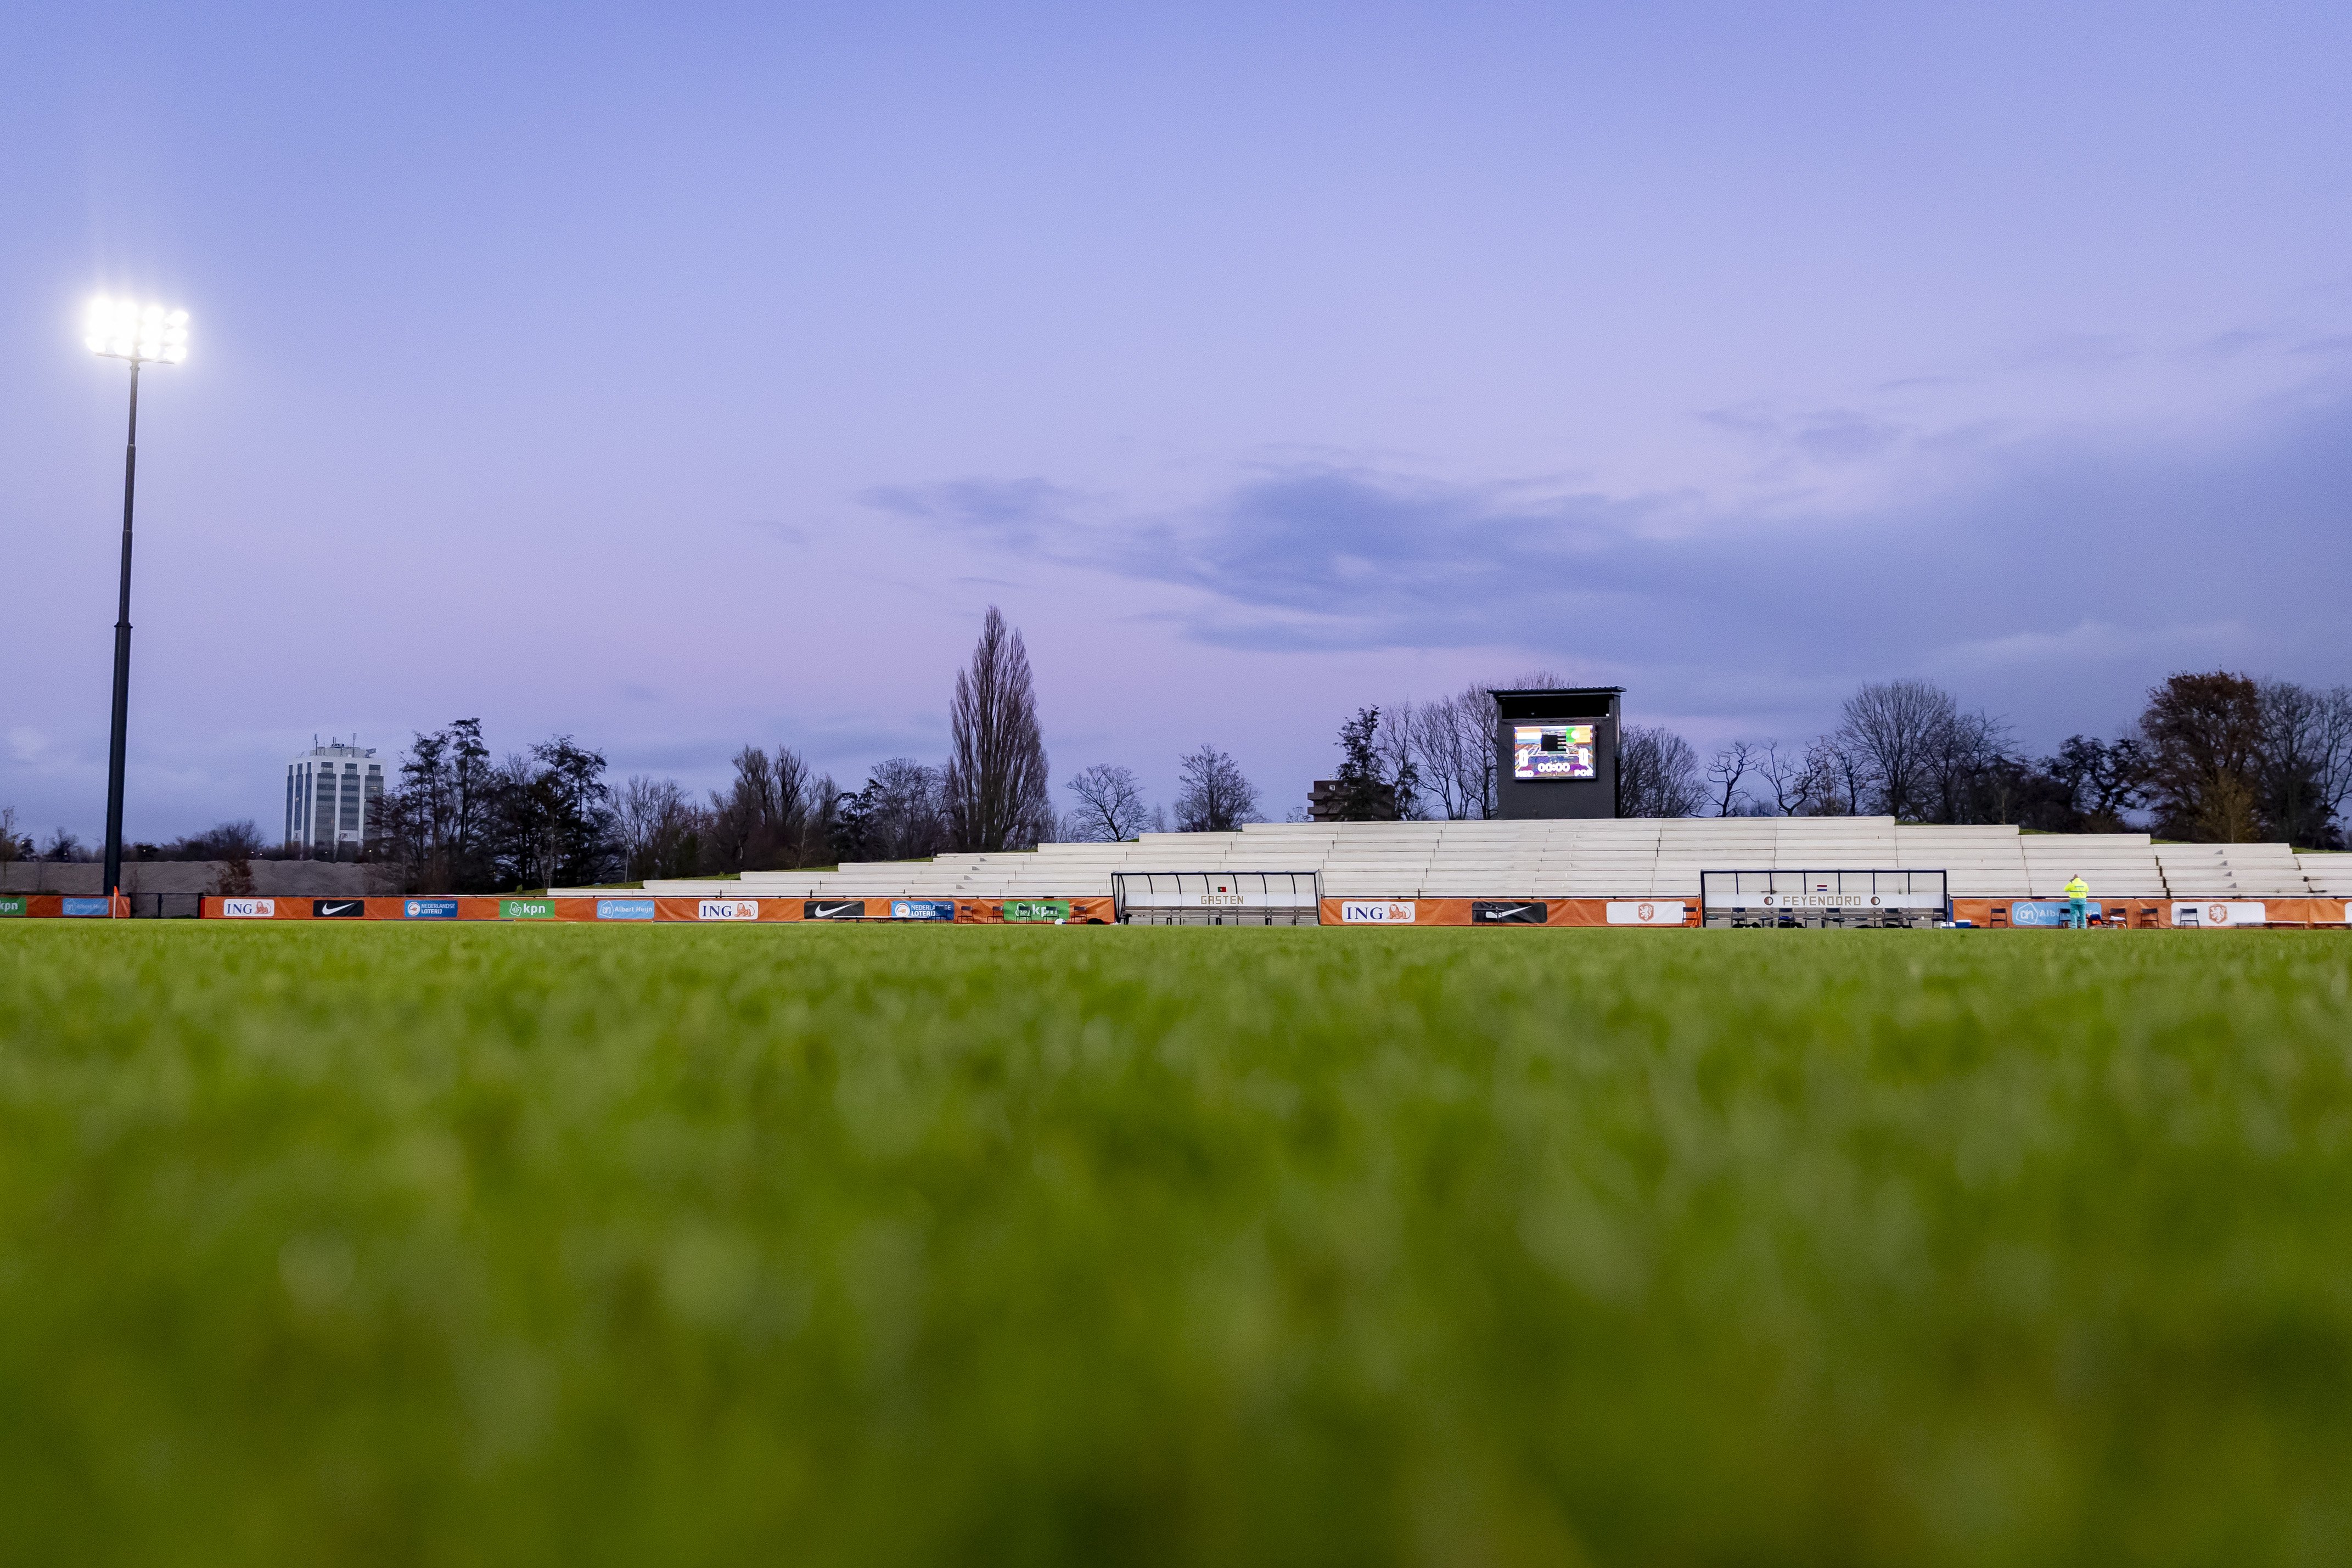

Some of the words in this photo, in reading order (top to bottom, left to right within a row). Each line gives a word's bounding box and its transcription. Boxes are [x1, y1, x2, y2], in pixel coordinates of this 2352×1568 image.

[1201, 896, 1243, 904] GASTEN
[1783, 896, 1861, 906] FEYENOORD
[227, 903, 252, 914] ING
[524, 903, 545, 915] kpn
[703, 906, 732, 917] ING
[1346, 907, 1383, 919] ING
